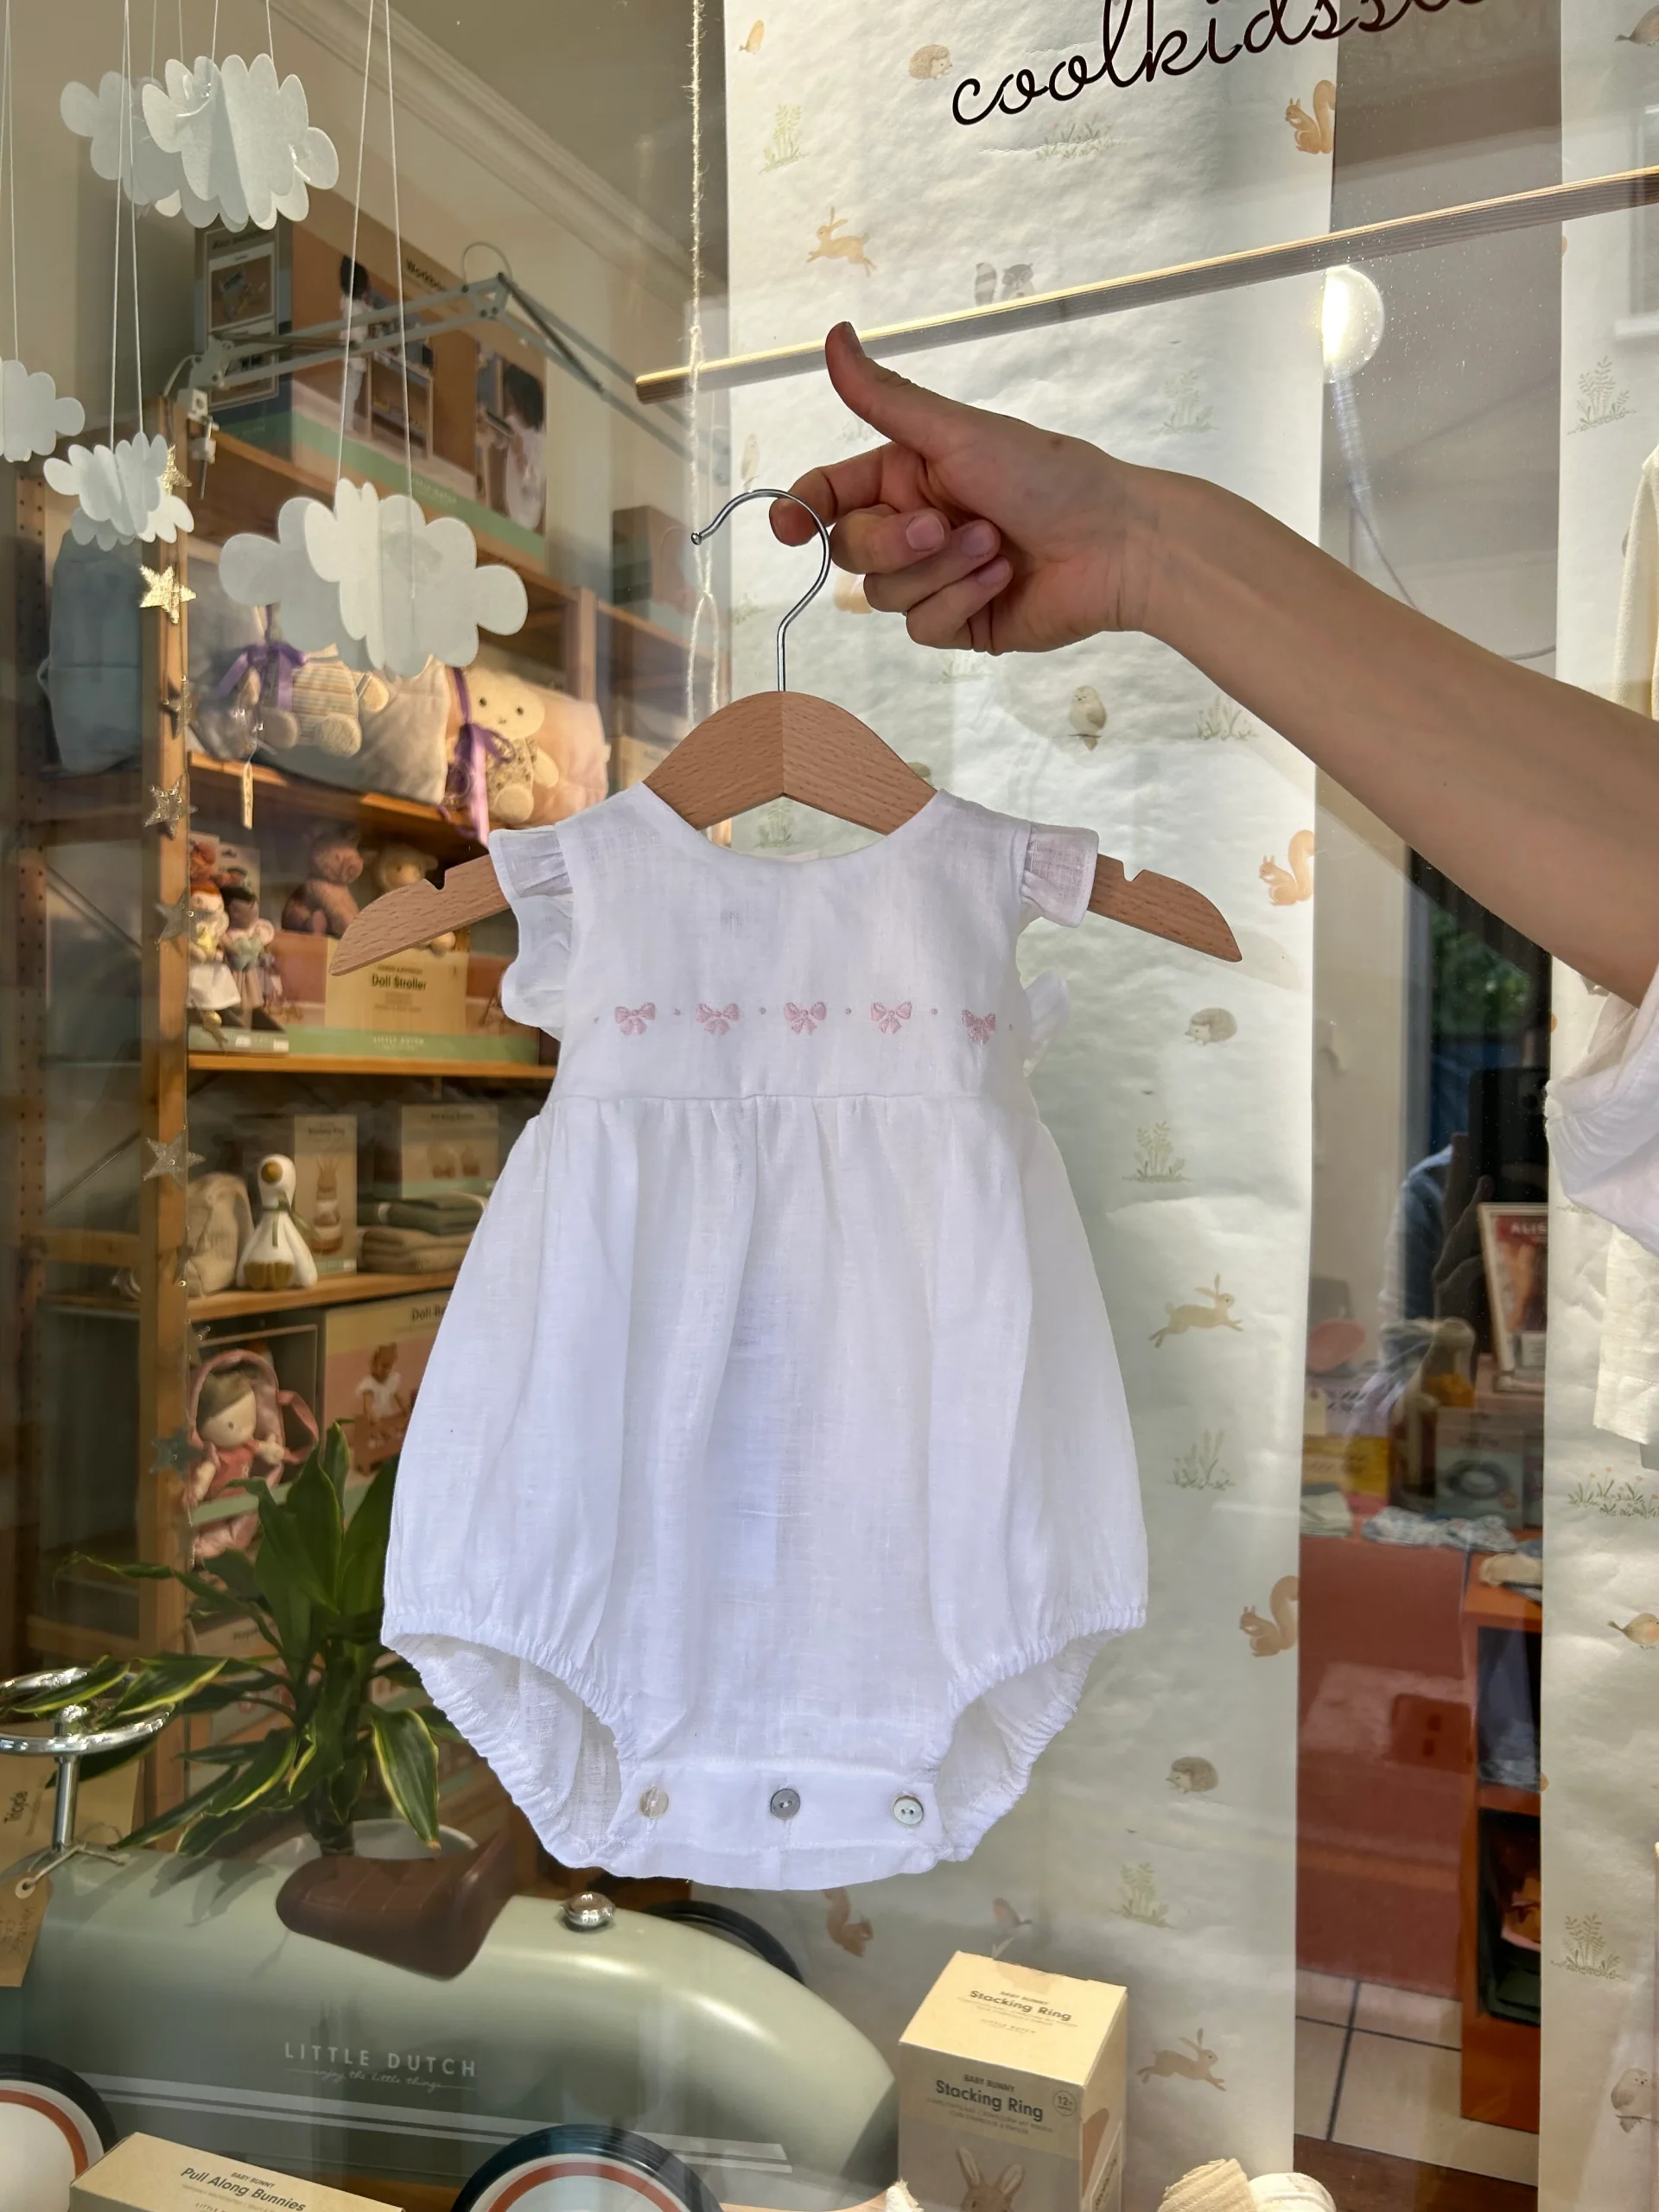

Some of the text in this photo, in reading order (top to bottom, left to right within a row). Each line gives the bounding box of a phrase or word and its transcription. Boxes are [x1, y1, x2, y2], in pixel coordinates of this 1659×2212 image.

[372, 973, 427, 991] Doll Stroller
[412, 1306, 431, 1322] Doll
[969, 1990, 1033, 2012] Stacking
[1037, 2006, 1071, 2022] Ring
[285, 2042, 475, 2077] LITTLE DUTCH
[936, 2079, 1002, 2112] Stacking
[1008, 2097, 1044, 2122] Ring
[181, 2167, 210, 2183] Pull
[207, 2177, 250, 2197] Along
[251, 2188, 306, 2212] Bunnies
[231, 2171, 276, 2189] BABY BUNNY
